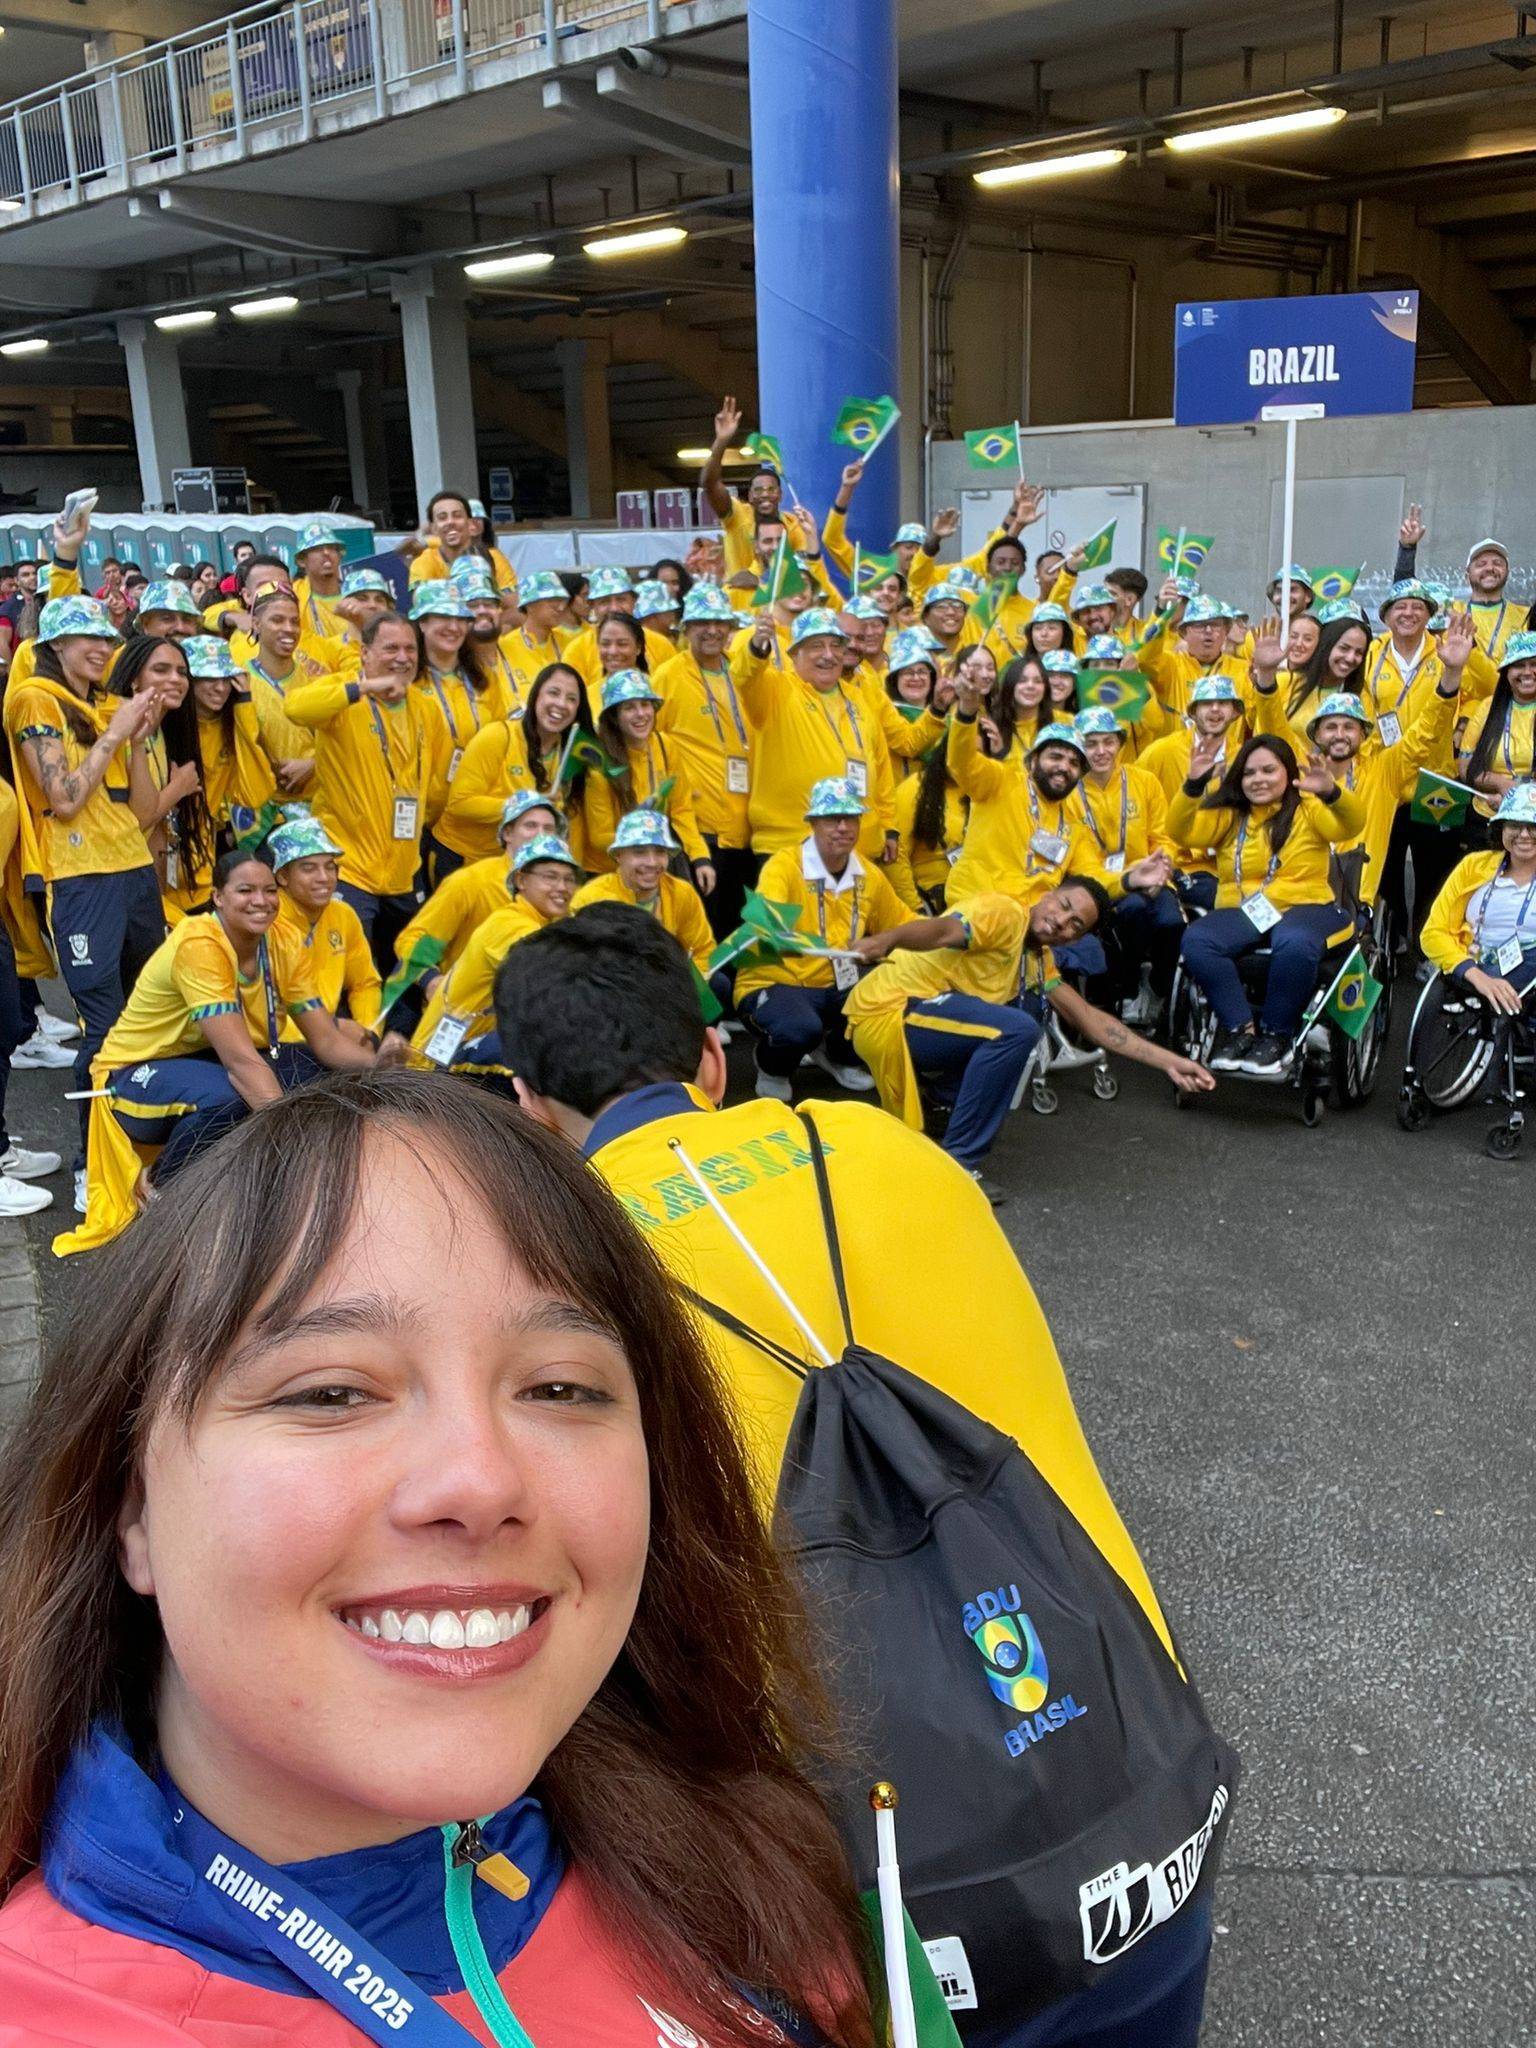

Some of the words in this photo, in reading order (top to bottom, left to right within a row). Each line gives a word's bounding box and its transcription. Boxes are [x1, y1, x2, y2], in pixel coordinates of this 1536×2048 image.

[1249, 344, 1340, 386] BRAZIL
[621, 1129, 836, 1225] ASIL
[1004, 1694, 1088, 1758] BRASIL
[1086, 1867, 1122, 1896] TIME
[204, 1853, 354, 1979] RHINE-RUHR
[343, 1963, 415, 2030] 2025
